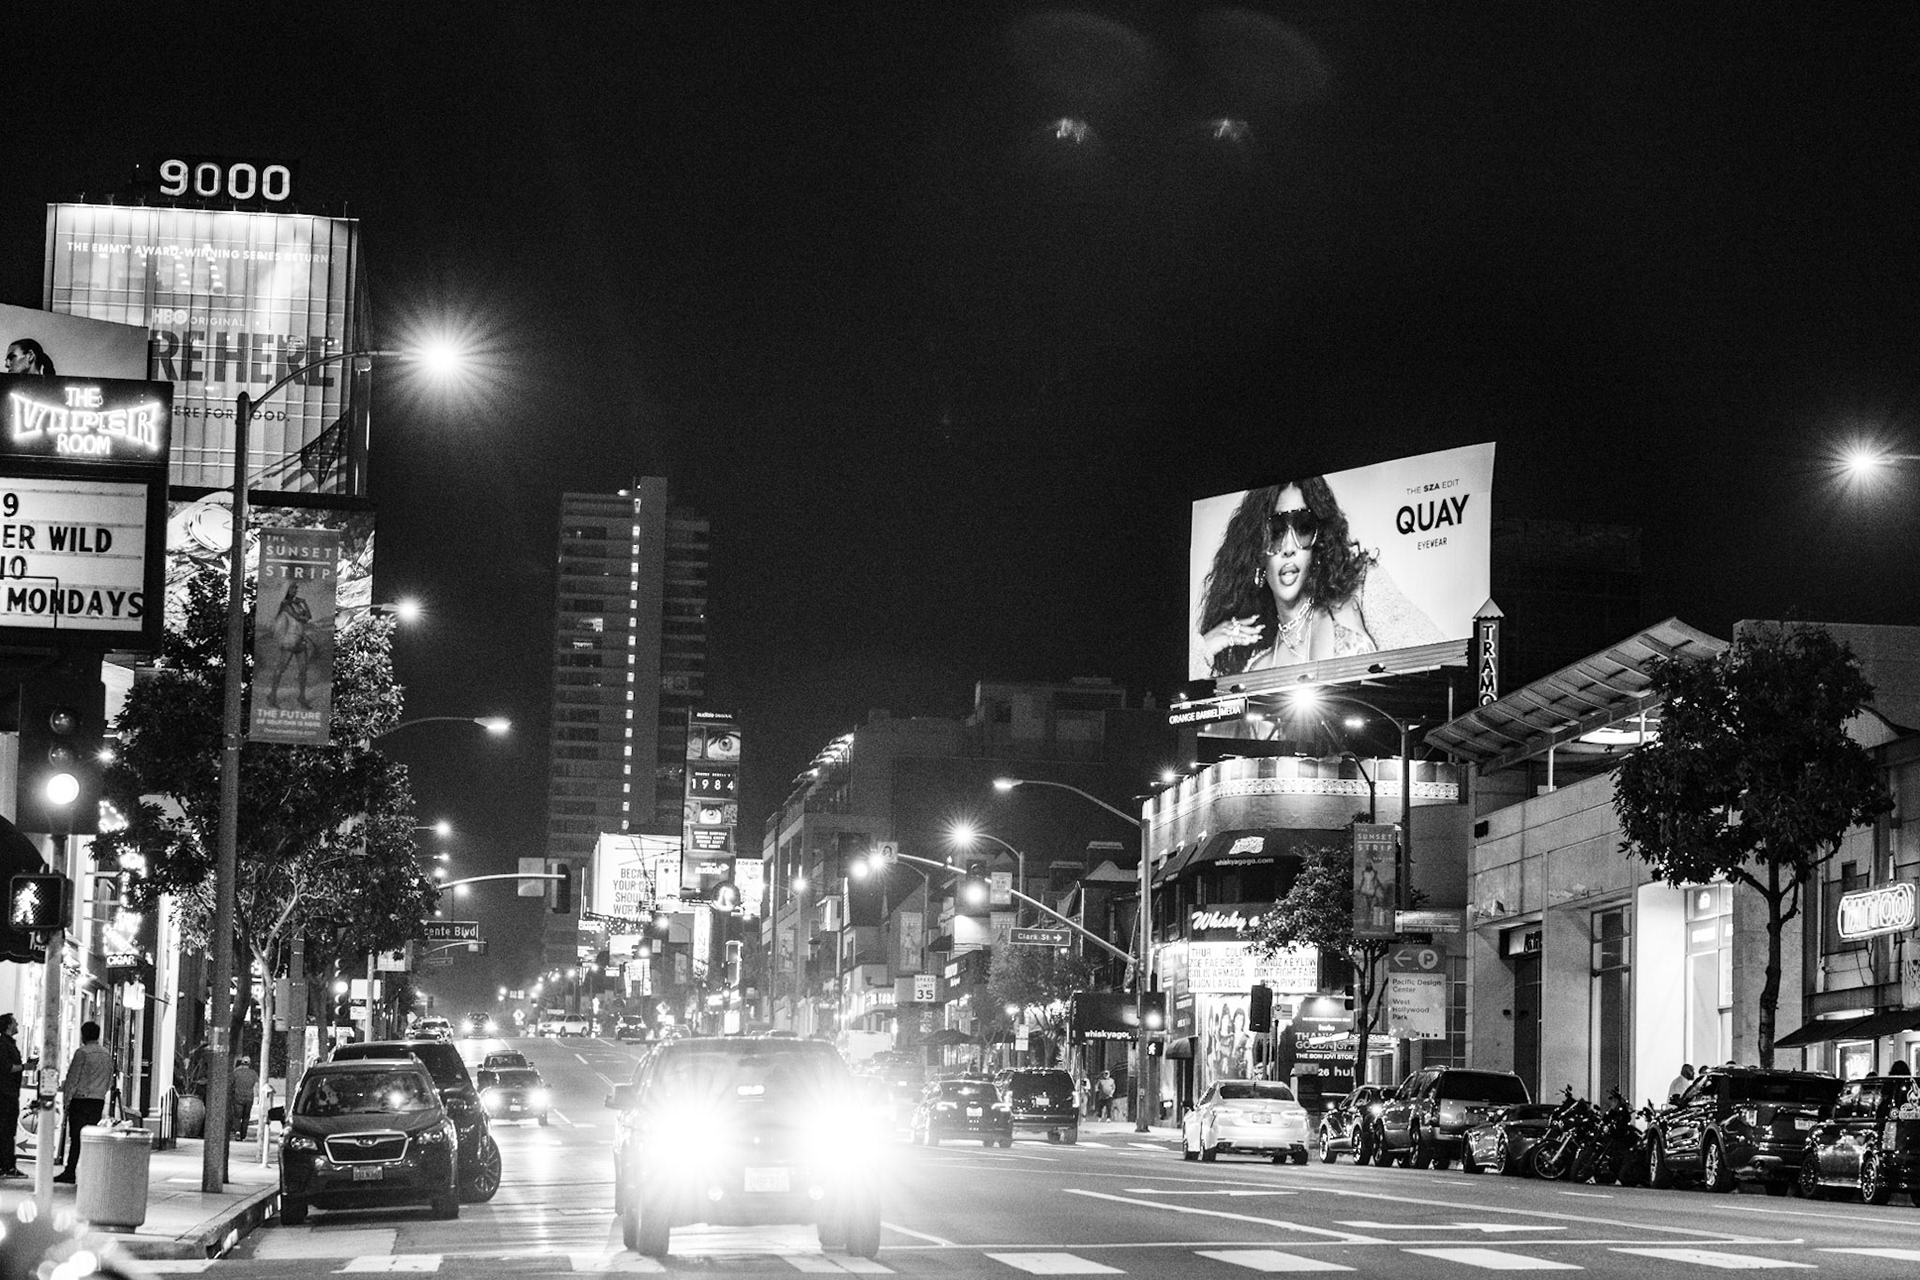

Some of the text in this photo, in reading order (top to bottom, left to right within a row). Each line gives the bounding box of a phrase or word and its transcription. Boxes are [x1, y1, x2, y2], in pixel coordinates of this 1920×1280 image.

[160, 159, 290, 200] 9000
[67, 241, 89, 252] THE
[152, 307, 246, 328] HBO ORIGINAL
[174, 406, 290, 422] ERE FOR OOD.
[10, 387, 160, 454] THE VIPER ROOM
[1406, 479, 1459, 495] THE SZA EDIT
[3, 493, 19, 517] 9
[1396, 494, 1470, 535] QUAY
[48, 526, 112, 553] WILD
[1417, 537, 1448, 550] EYEWEAR
[266, 545, 332, 558] SUNSET
[266, 565, 331, 580] STRIP
[7, 587, 144, 618] MONDAYS
[256, 708, 321, 720] THE FUTURE
[1168, 712, 1196, 725] ORANGE
[1220, 705, 1241, 717] MEDIA
[691, 778, 734, 790] 1984
[1357, 833, 1392, 841] SUNSET
[1357, 844, 1392, 852] STRIP
[620, 868, 656, 879] BECAUS
[613, 880, 636, 891] YOUR
[1191, 910, 1247, 933] Whisky
[424, 925, 476, 937] cente Blvd
[1017, 933, 1050, 941] Clark St
[106, 955, 137, 967] CIGAR
[1423, 953, 1434, 965] P
[1392, 978, 1442, 987] Pacific Design
[916, 989, 934, 1000] 35
[1392, 1006, 1430, 1014] Hollywood
[1318, 1024, 1336, 1032] hulu
[1317, 1068, 1330, 1077] 26
[1334, 1066, 1355, 1077] hul
